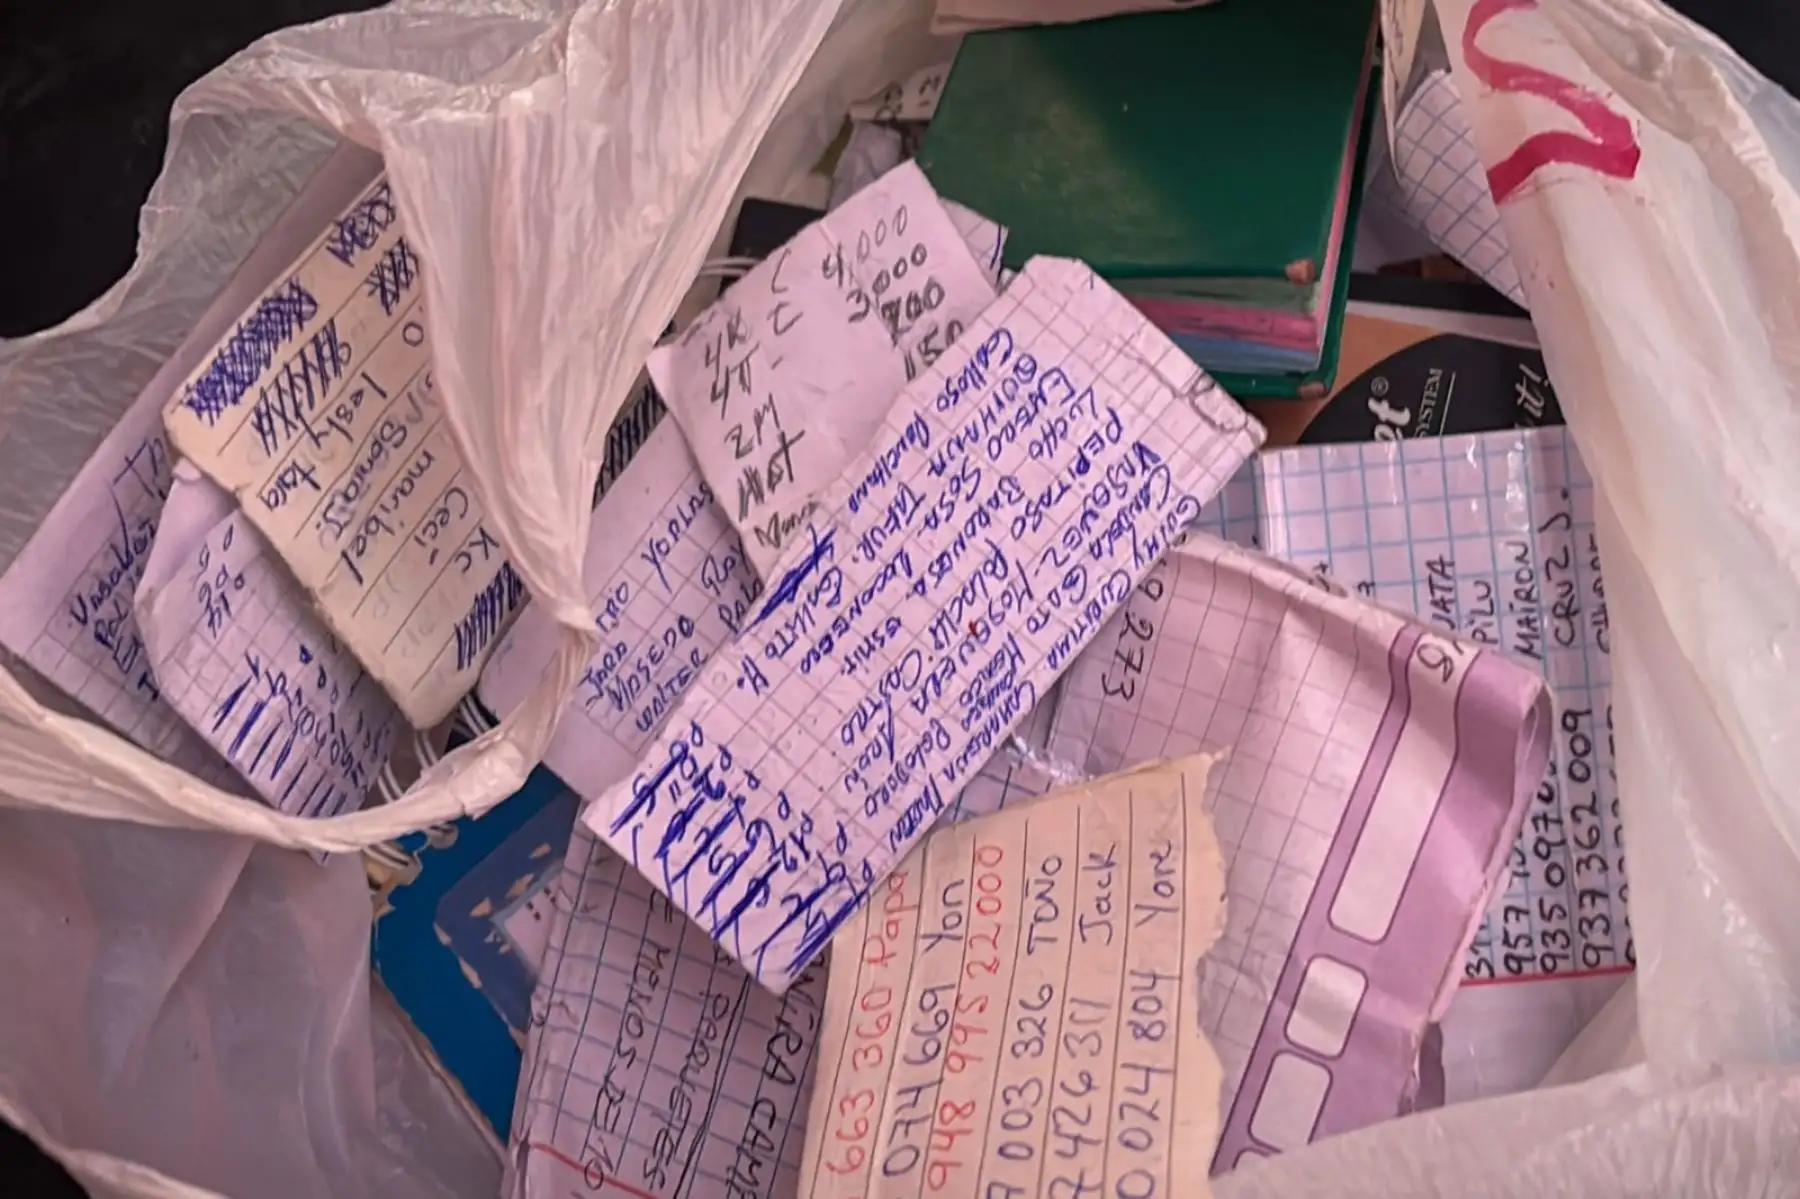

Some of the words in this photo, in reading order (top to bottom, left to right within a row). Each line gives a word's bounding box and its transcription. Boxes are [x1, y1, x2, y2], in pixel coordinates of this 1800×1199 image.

[1101, 611, 1154, 702] 273
[1561, 708, 1593, 782] 009
[1572, 790, 1616, 876] 362
[920, 879, 971, 953] Yon
[1071, 842, 1117, 946] Jack
[1533, 897, 1571, 974] 935
[1578, 888, 1621, 970] 937
[1501, 905, 1540, 976] 957
[902, 983, 957, 1070] 669
[944, 991, 989, 1074] 995
[1010, 983, 1054, 1059] 326
[1127, 969, 1182, 1042] 804
[825, 1089, 875, 1175] 663
[882, 1079, 943, 1182] 074
[927, 1099, 977, 1192] 948
[996, 1077, 1043, 1161] 003
[1107, 1062, 1175, 1152] 024
